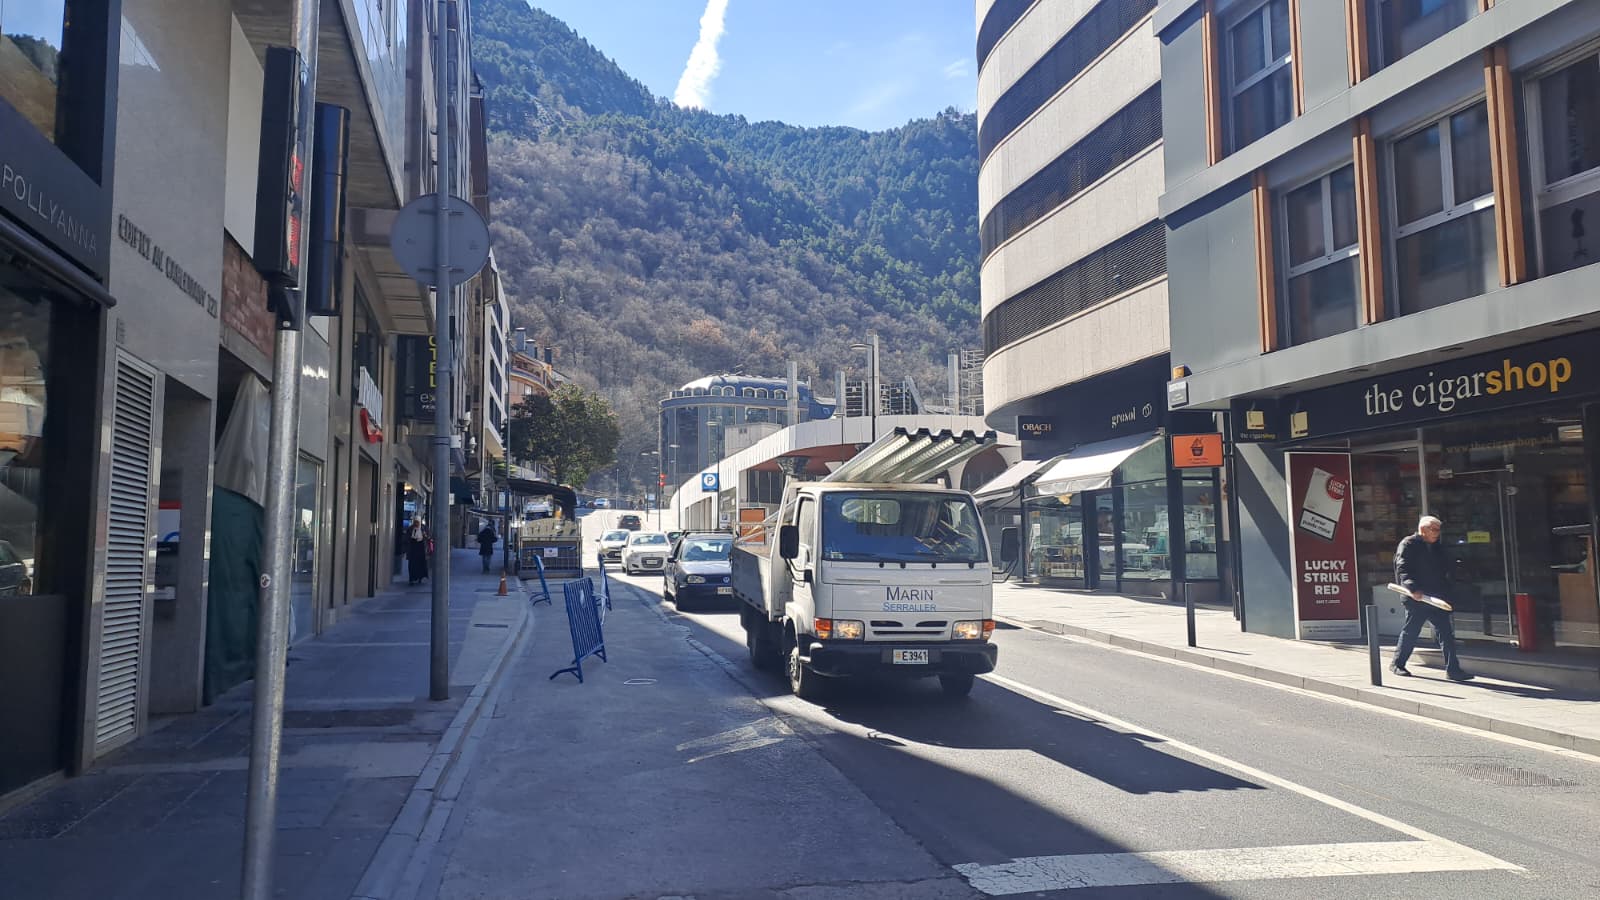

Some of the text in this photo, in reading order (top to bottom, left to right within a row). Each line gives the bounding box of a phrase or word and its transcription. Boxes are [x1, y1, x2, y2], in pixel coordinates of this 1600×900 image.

[2, 164, 97, 256] POLLYANNA
[1364, 356, 1573, 416] the cigarshop
[1022, 423, 1052, 431] OBACH
[707, 476, 714, 484] P
[1304, 560, 1346, 571] LUCKY
[1303, 572, 1350, 583] STRIKE
[886, 586, 934, 601] MARIN
[1314, 584, 1340, 595] RED
[882, 601, 937, 612] SERRALLER
[902, 650, 928, 661] E3941
